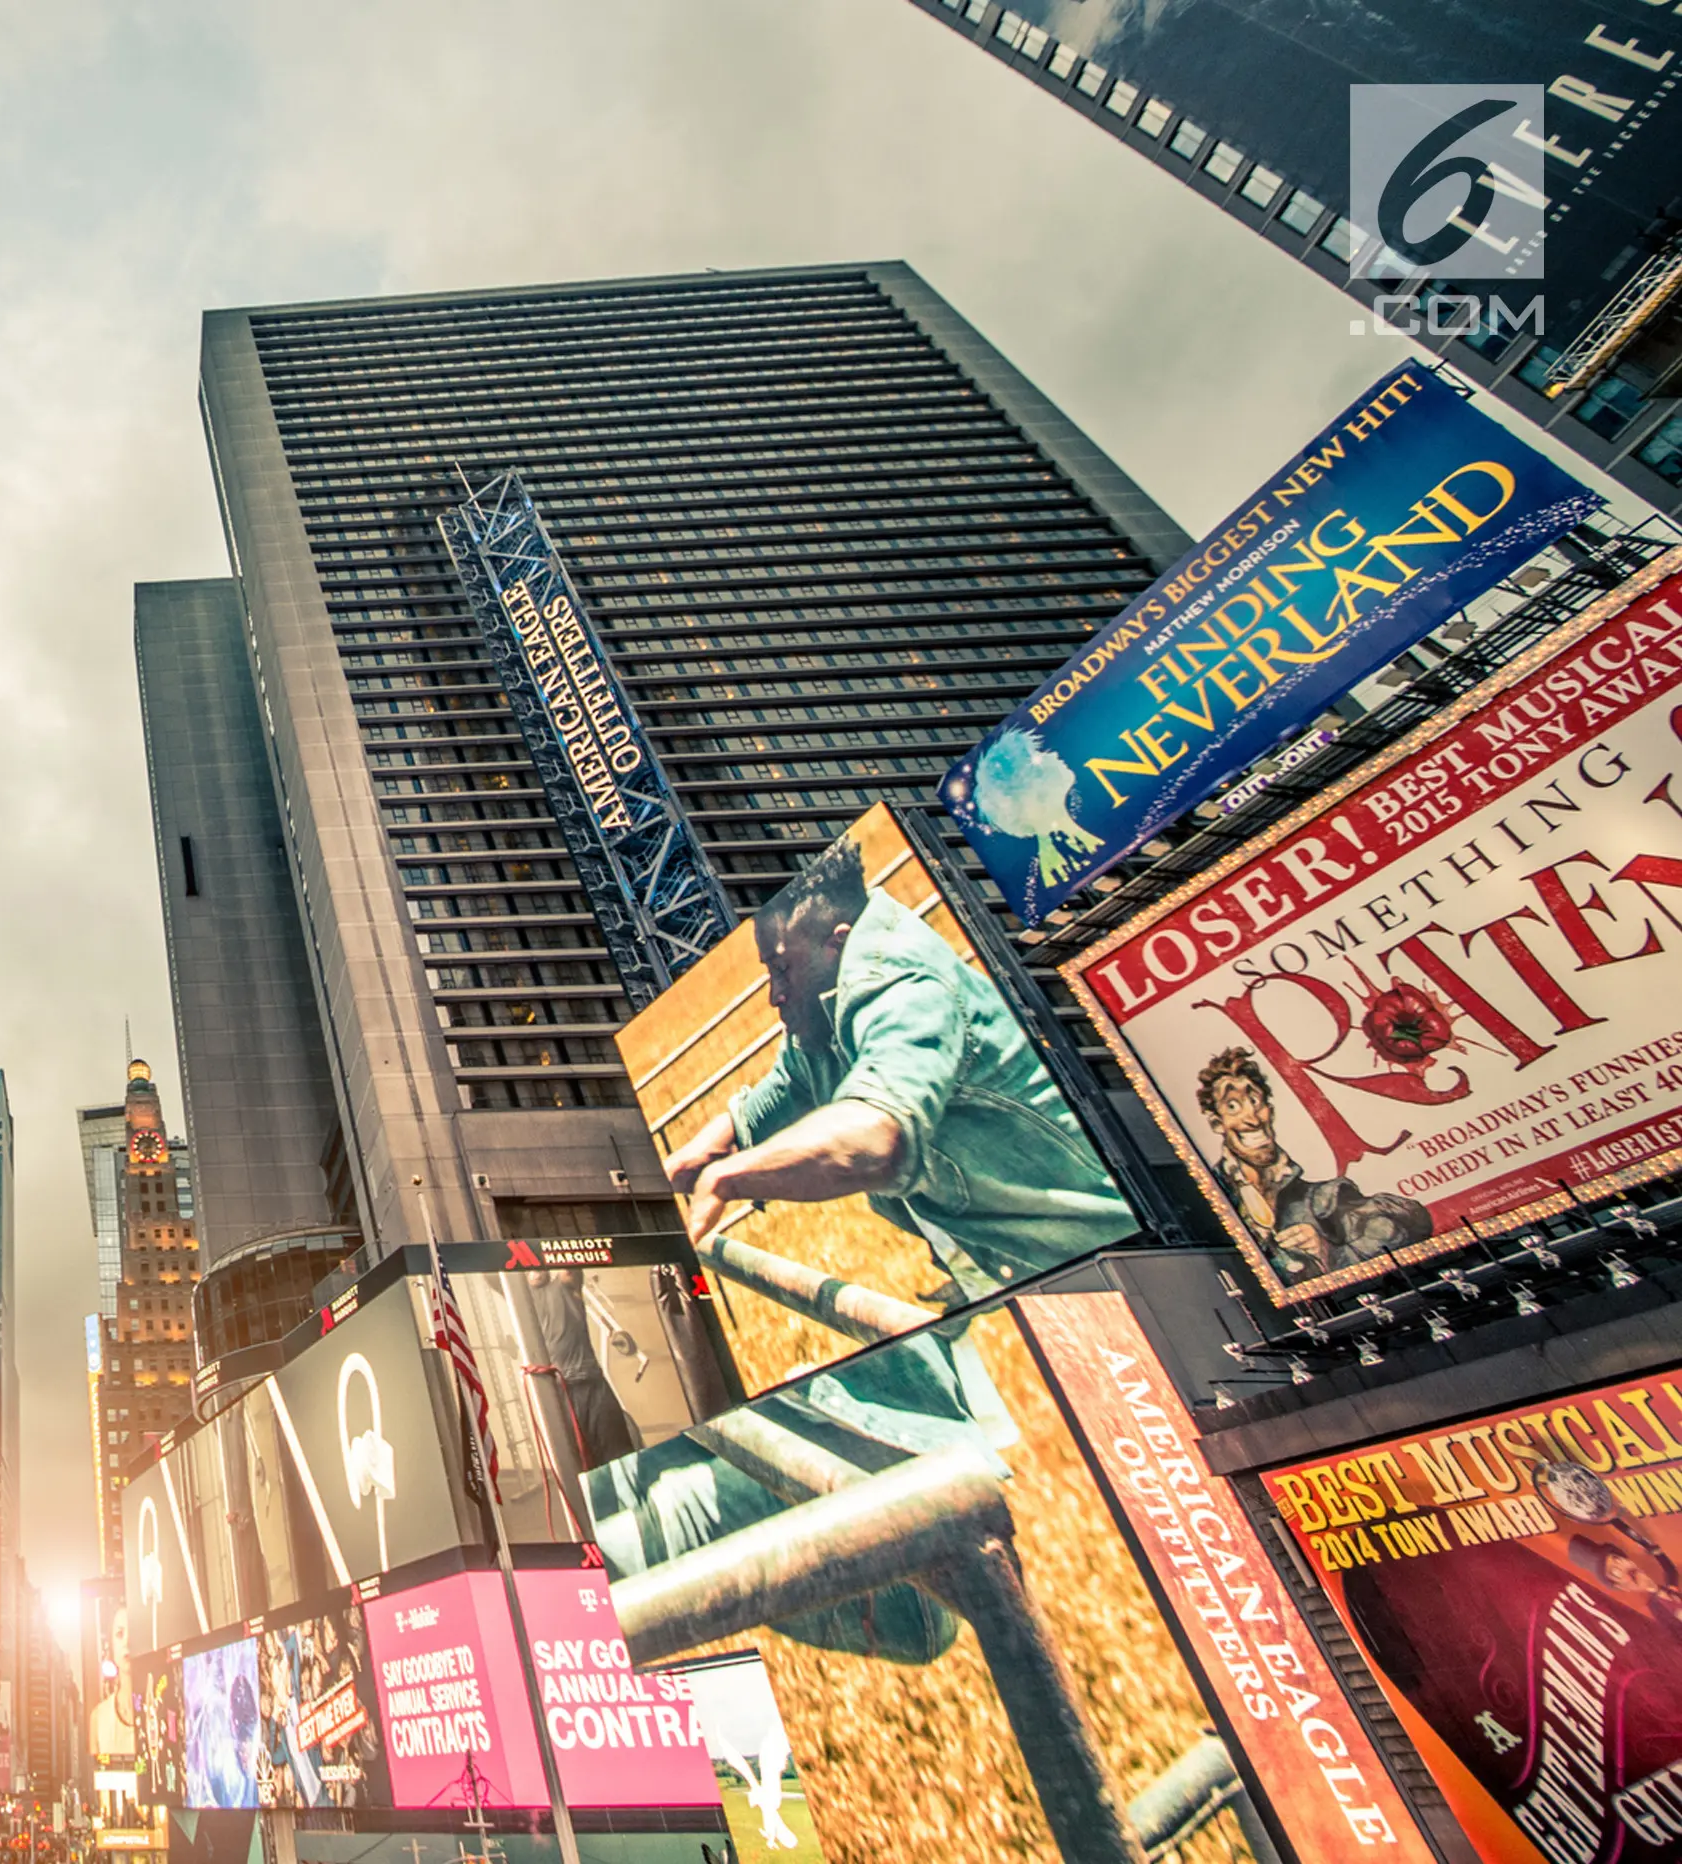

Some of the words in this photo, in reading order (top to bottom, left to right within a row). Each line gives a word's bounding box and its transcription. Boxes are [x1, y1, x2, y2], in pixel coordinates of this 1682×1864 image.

[1572, 166, 1602, 195] THE
[1028, 600, 1166, 725] BROADWAY'S
[1163, 500, 1274, 606] BIGGEST
[1272, 434, 1347, 508] NEW
[1344, 373, 1424, 442] HIT!
[1143, 590, 1215, 656] MATTHEW
[1216, 518, 1302, 593] MORRISON
[502, 579, 557, 670] EAGLE
[1084, 460, 1516, 809] NEVERLAND
[1136, 508, 1367, 704] FINDING
[542, 595, 642, 773] OUTFITTERS
[537, 664, 632, 829] AMERICAN
[1362, 740, 1474, 825] BEST
[1385, 789, 1464, 848] 2015
[1461, 724, 1577, 801] TONY
[1233, 742, 1632, 992] SOMETHING
[1097, 813, 1379, 1012] LOSER!
[1396, 1146, 1495, 1199] COMEDY
[1493, 1133, 1529, 1160] IN
[1529, 1117, 1565, 1147] AT
[1563, 1081, 1654, 1131] LEAST
[540, 1238, 613, 1251] MARRIOTT
[1469, 1195, 1509, 1215] American
[544, 1250, 610, 1264] MARQUIS
[1273, 1451, 1418, 1535] BEST
[1310, 1530, 1382, 1571] 2014
[1374, 1511, 1453, 1561] TONY
[1446, 1495, 1559, 1548] AWARD
[1097, 1345, 1280, 1626] AMERICAN
[1256, 1639, 1398, 1846] EAGLE
[1111, 1436, 1282, 1721] OUTFITTERS
[382, 1657, 405, 1688] SAY
[403, 1649, 456, 1685] GOODBYE
[455, 1644, 474, 1675] TO
[387, 1686, 431, 1718] ANNUAL
[429, 1679, 482, 1713] SERVICE
[534, 1639, 585, 1671] SAY
[544, 1673, 655, 1704] ANNUAL
[334, 1688, 357, 1723] EVER
[390, 1710, 491, 1758] CONTRACTS
[1473, 1710, 1523, 1755] A
[1513, 1581, 1631, 1864] GENTLEMAN'S
